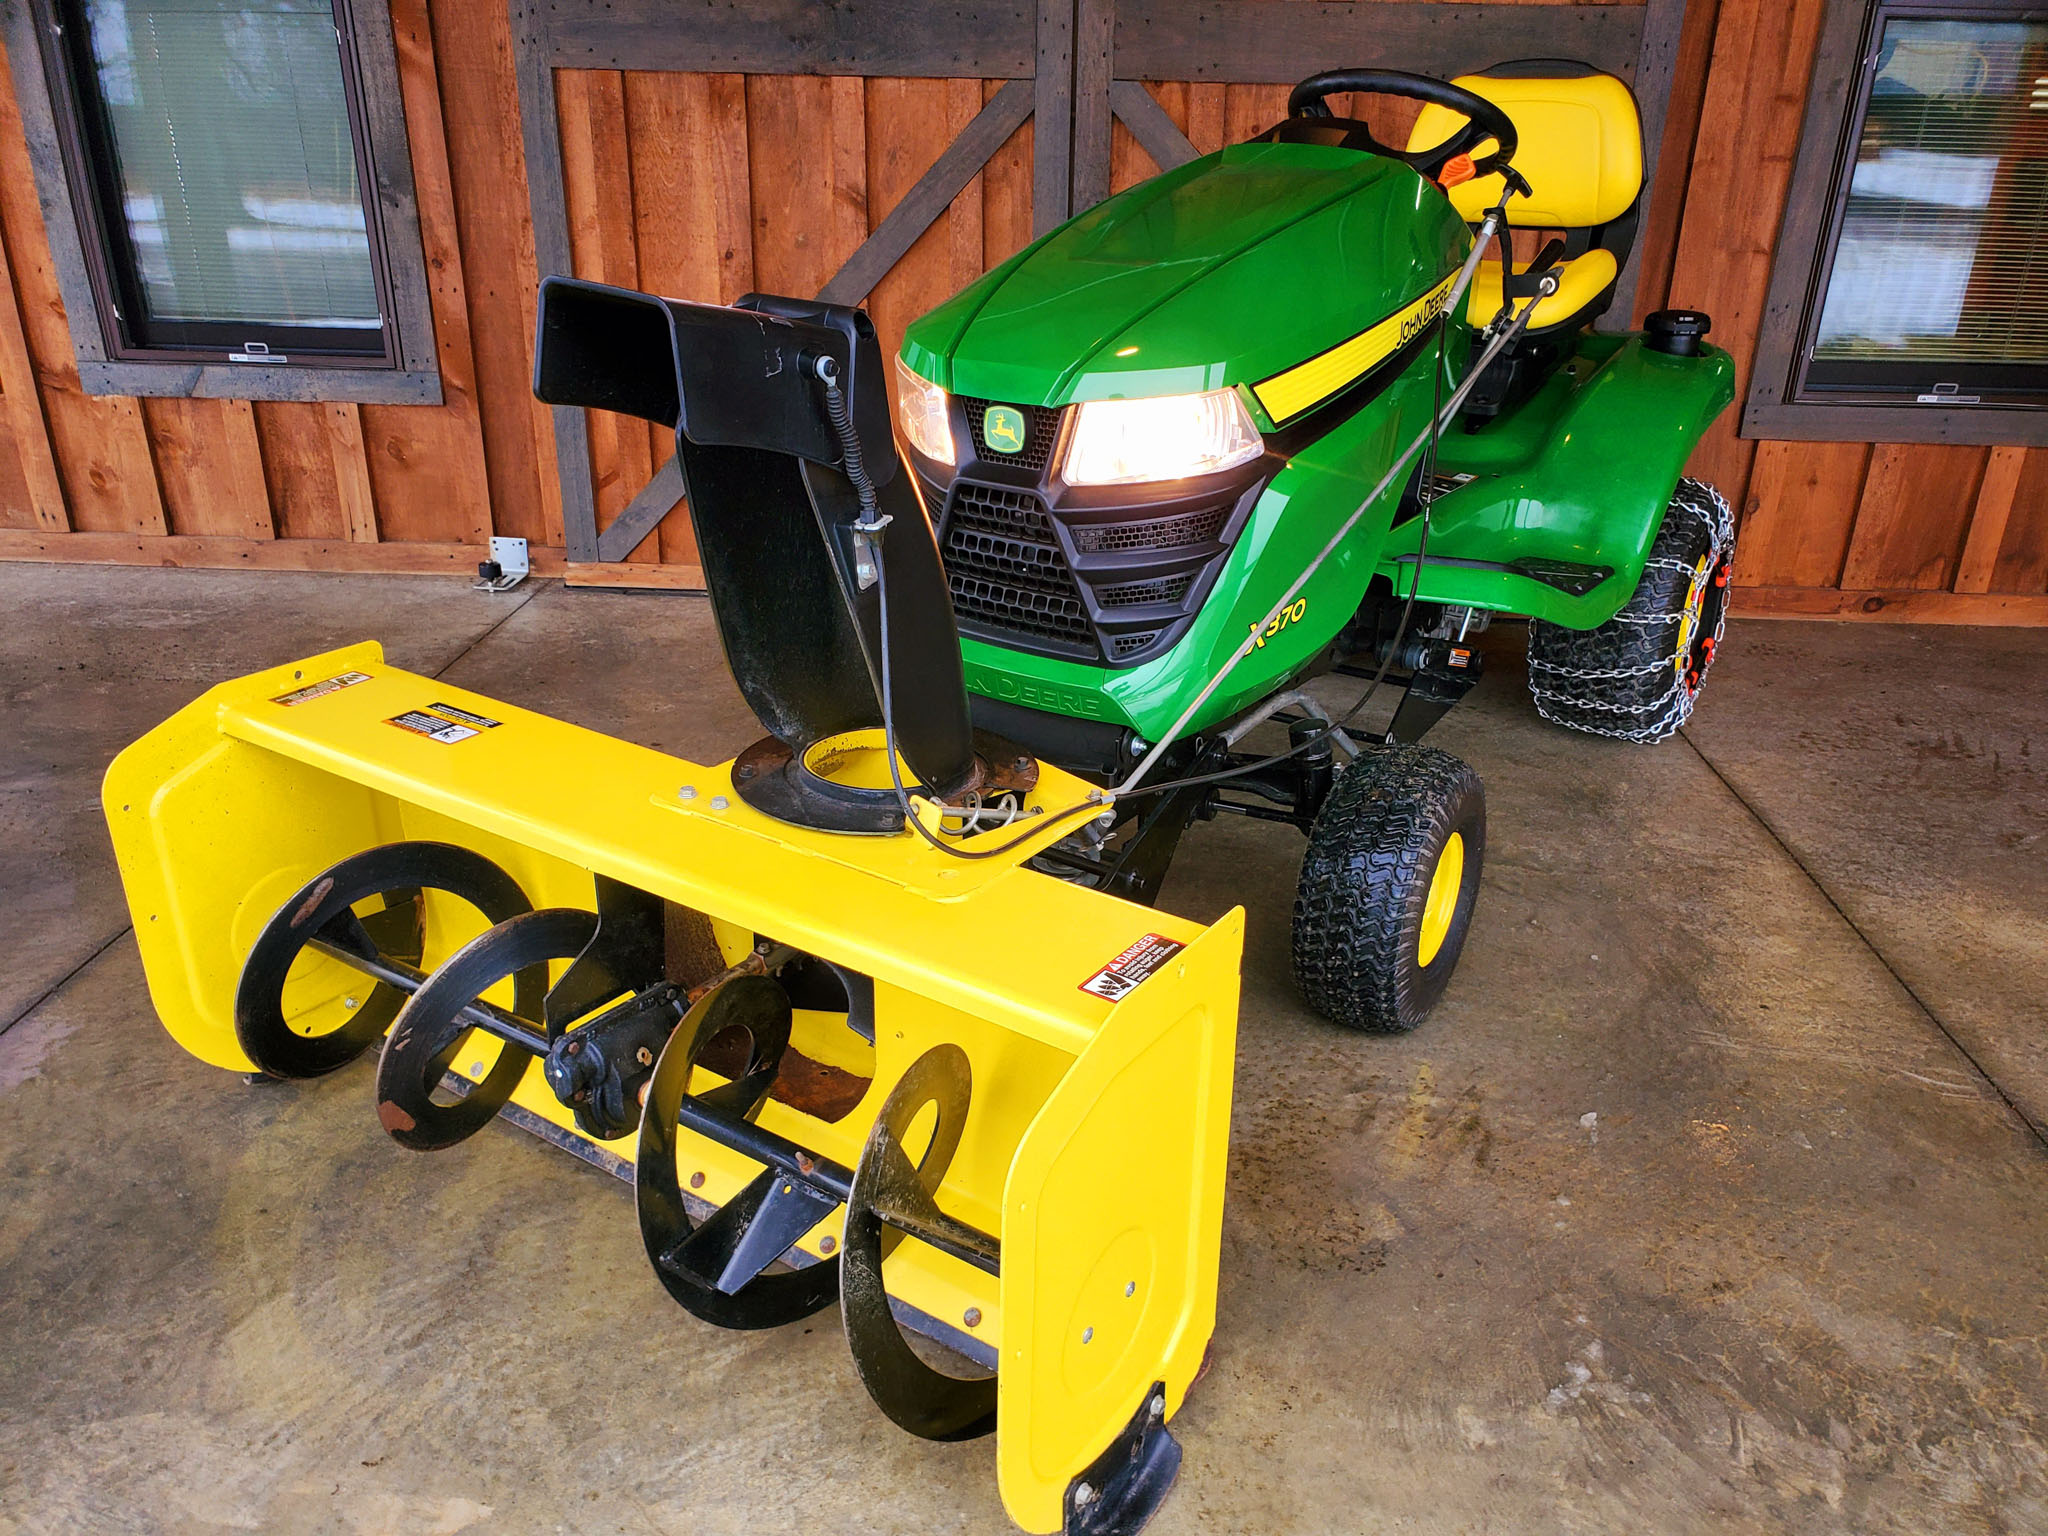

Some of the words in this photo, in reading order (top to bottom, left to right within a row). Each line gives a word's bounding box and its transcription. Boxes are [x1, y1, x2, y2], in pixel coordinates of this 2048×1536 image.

[1396, 309, 1423, 348] JOHN
[997, 677, 1101, 717] DEERE
[1115, 935, 1159, 964] DANGER
